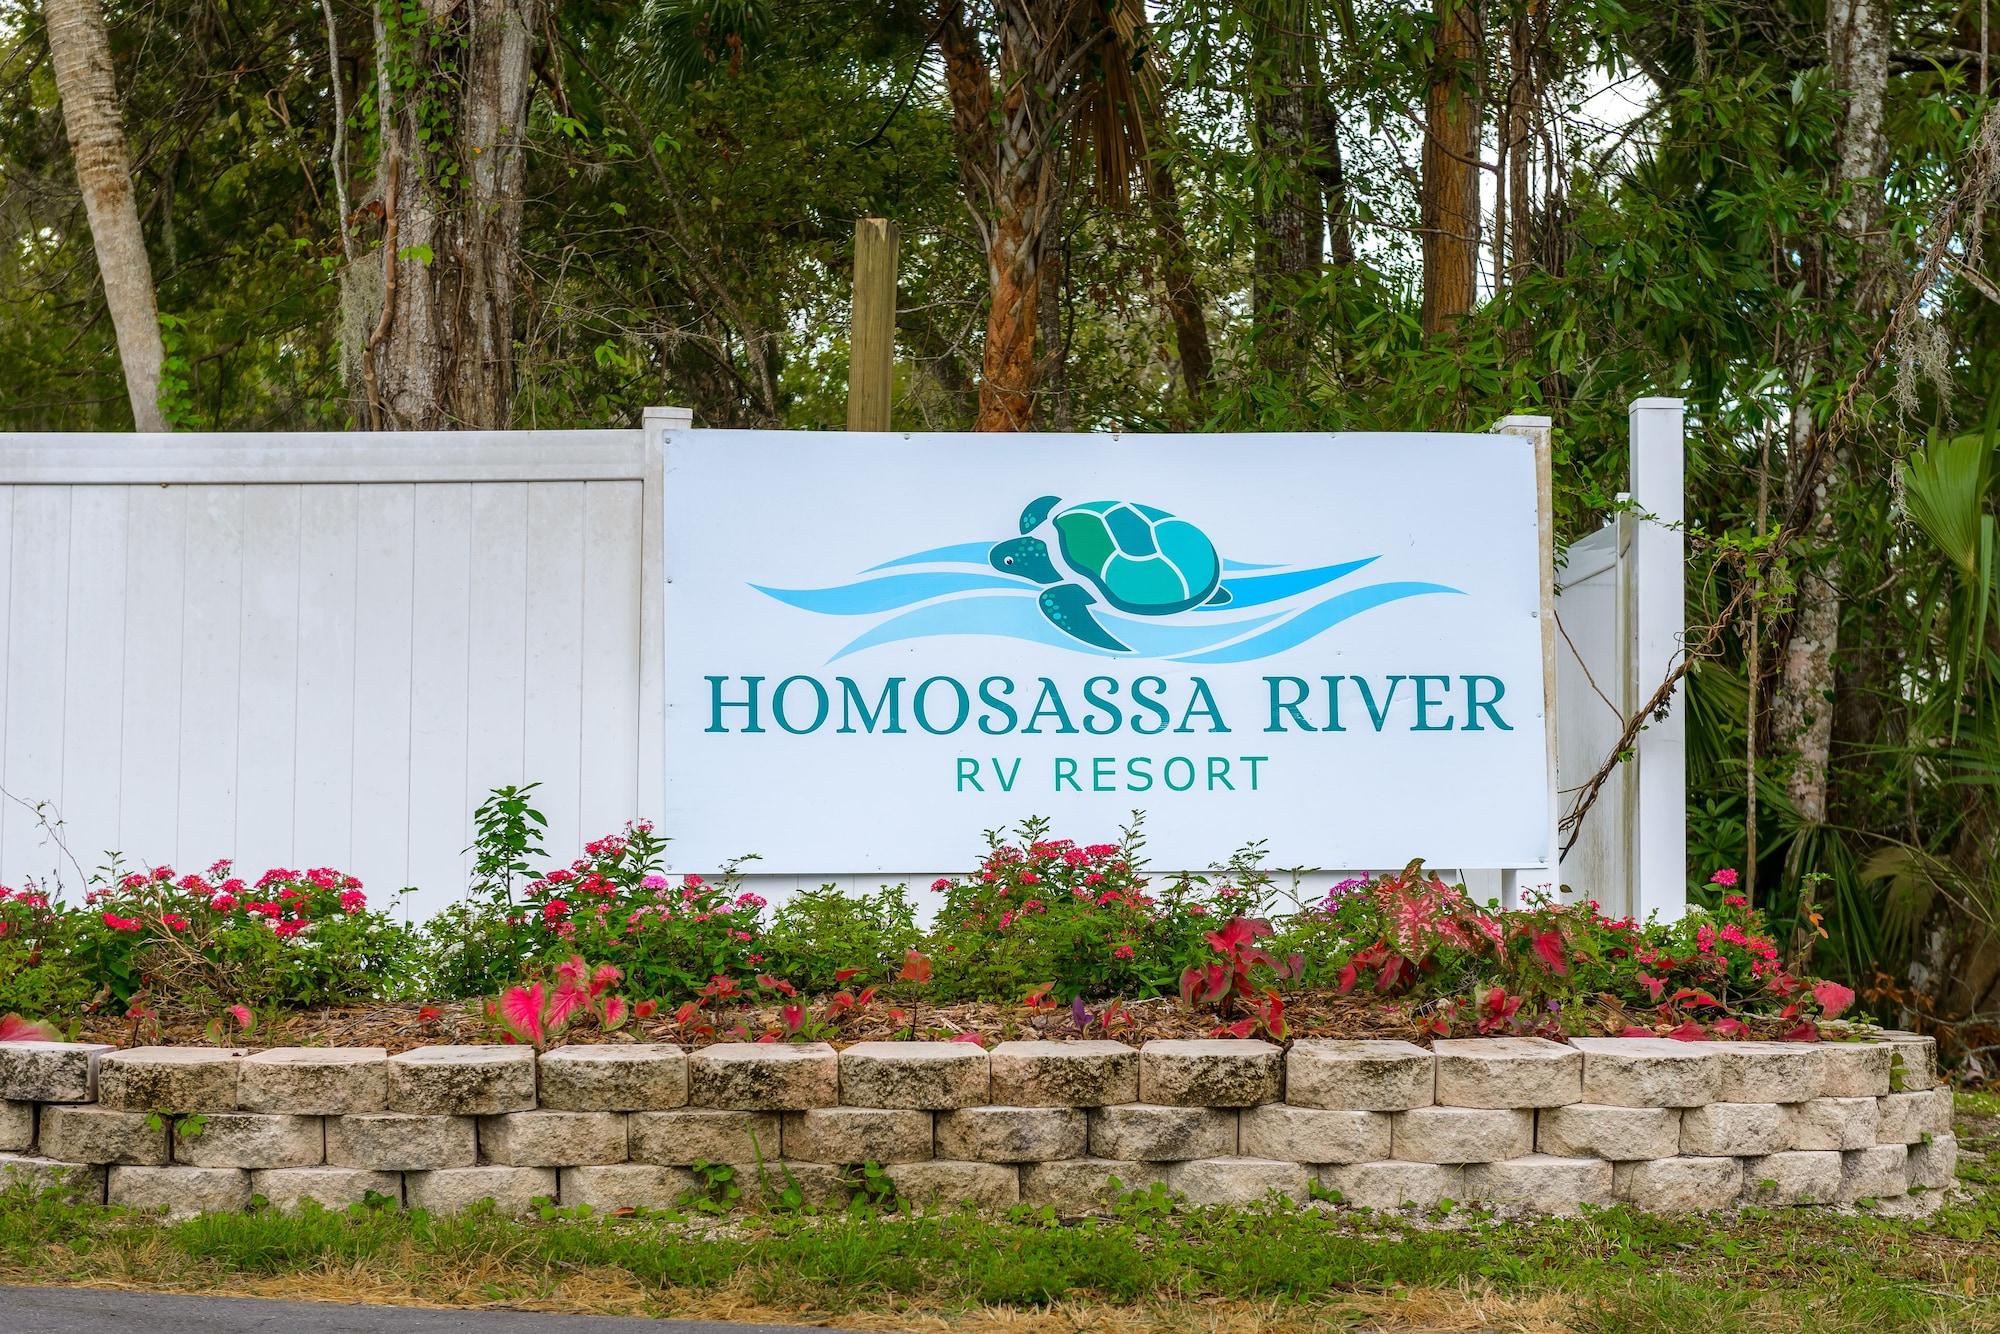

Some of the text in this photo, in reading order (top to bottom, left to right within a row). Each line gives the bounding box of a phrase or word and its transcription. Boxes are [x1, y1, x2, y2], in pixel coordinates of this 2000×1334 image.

[703, 674, 1514, 736] HOMOSASSA RIVER
[956, 756, 1269, 792] RV RESORT
